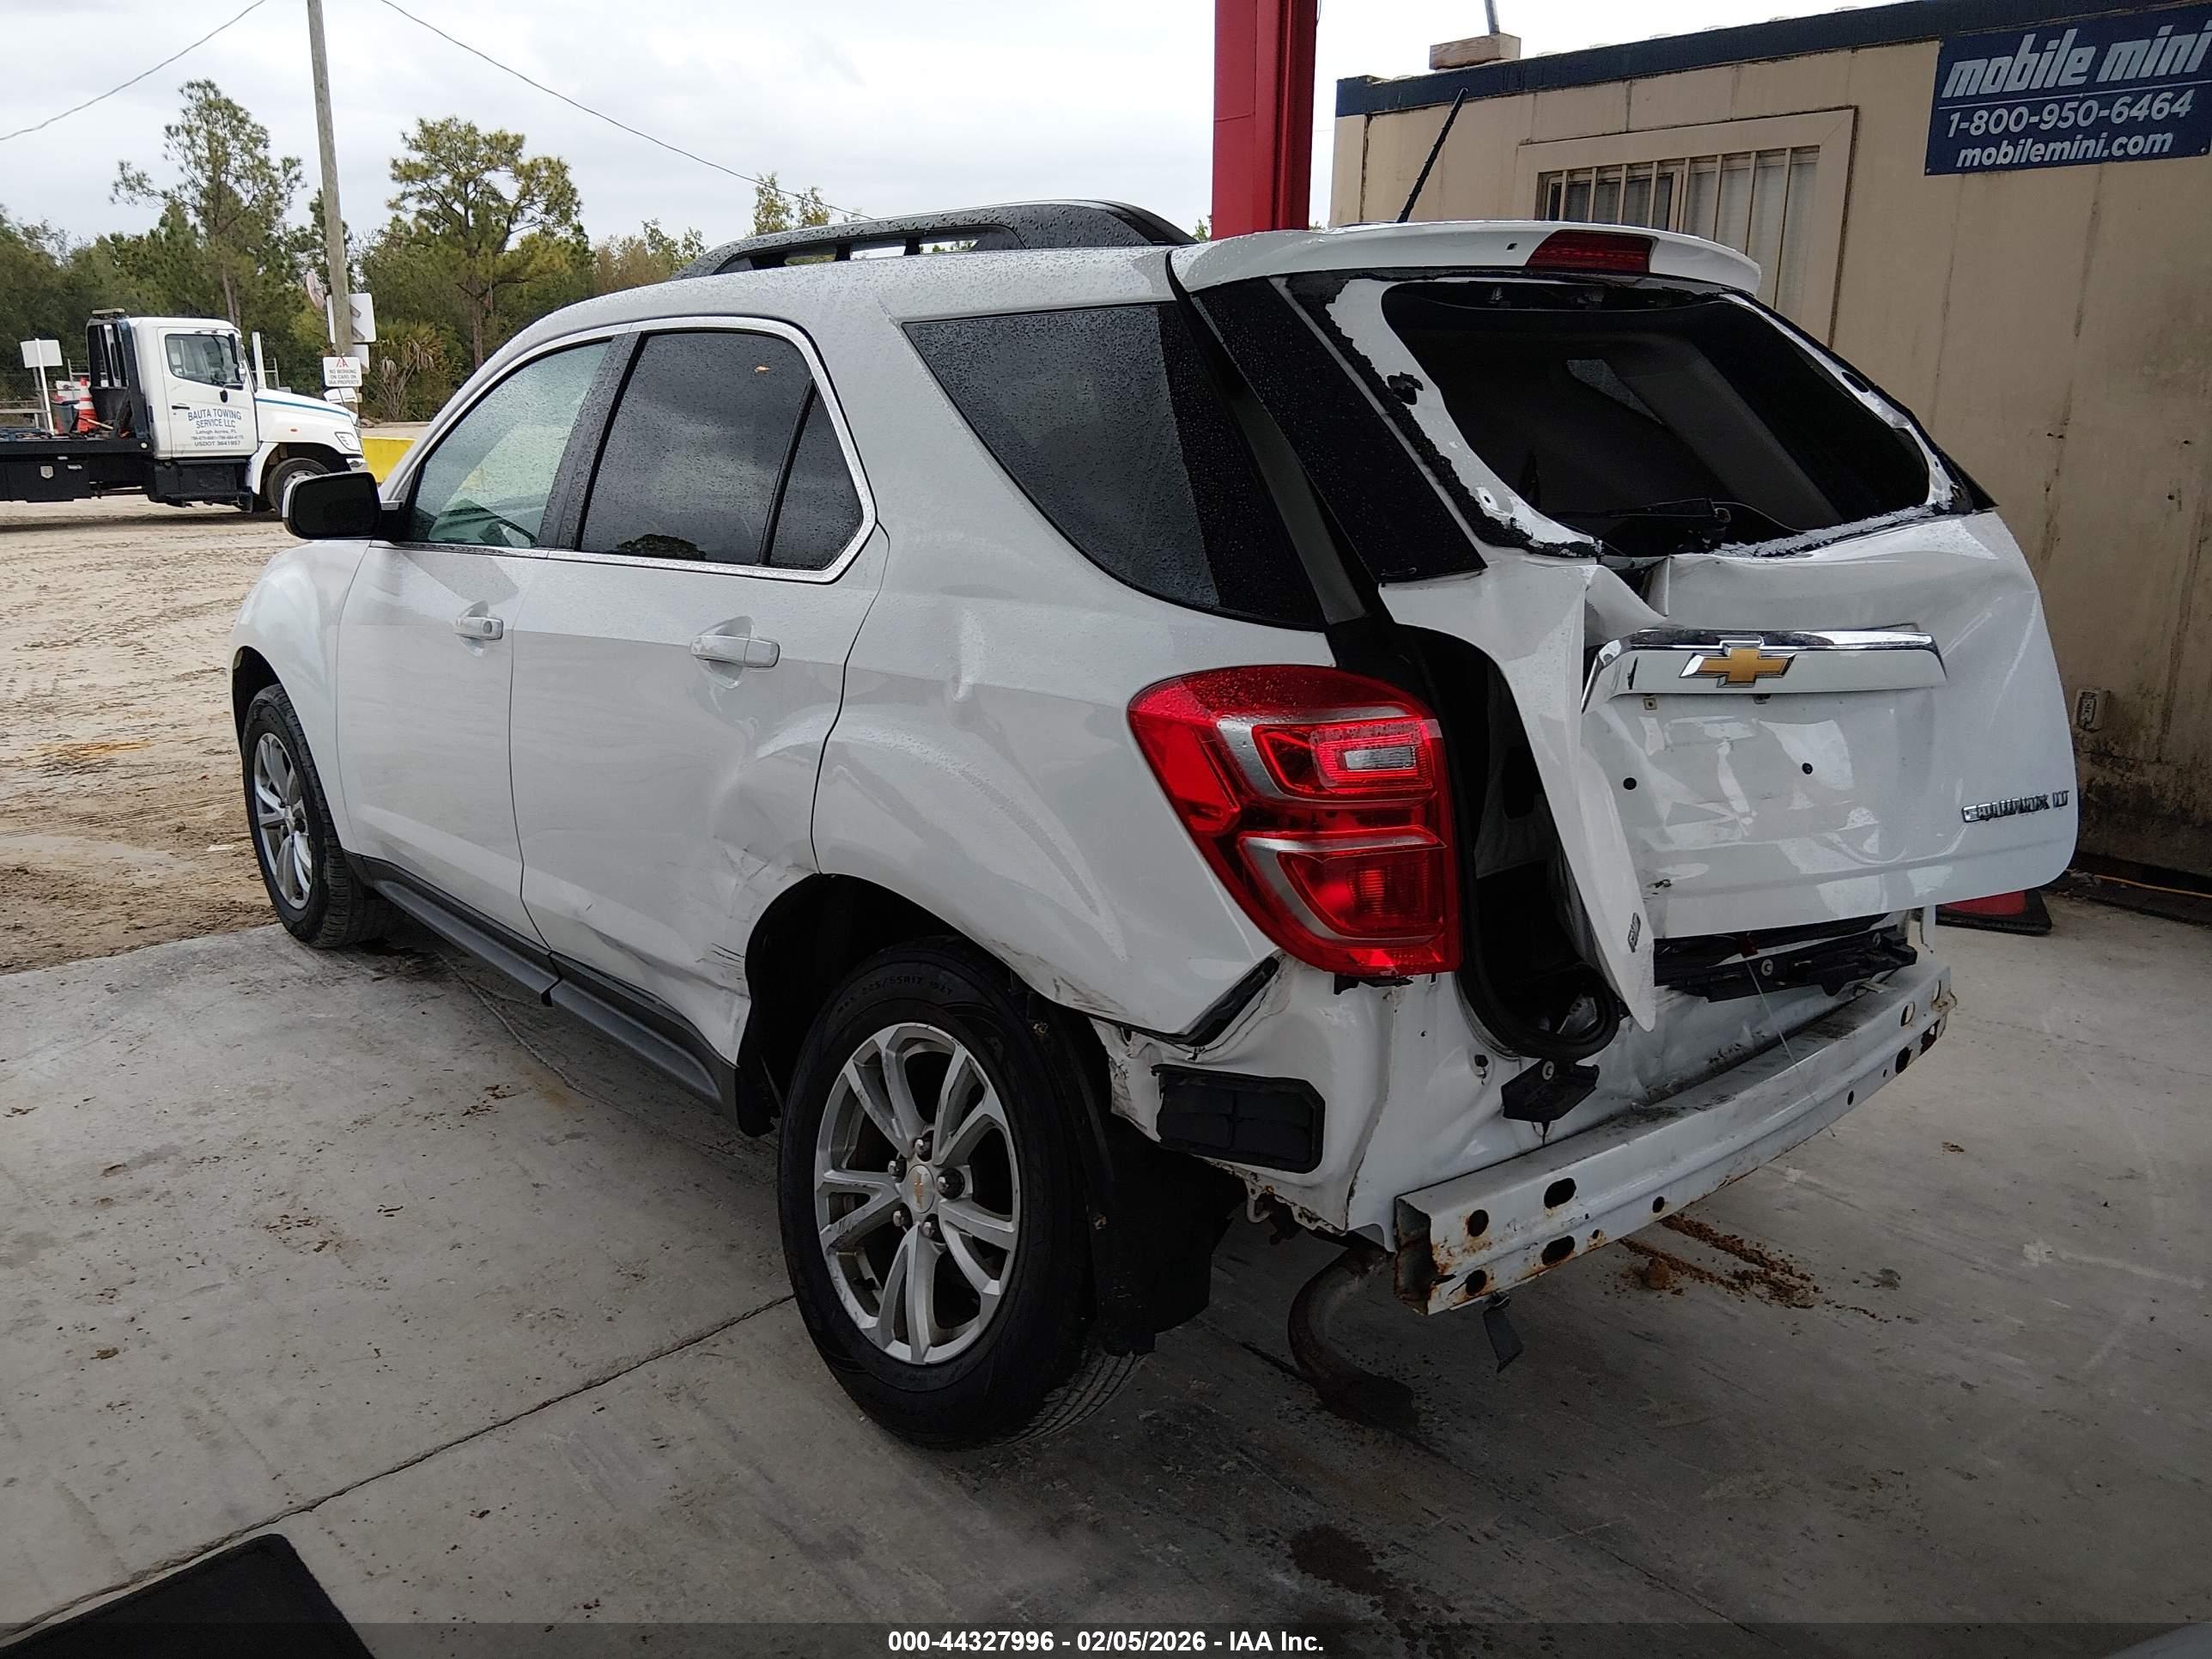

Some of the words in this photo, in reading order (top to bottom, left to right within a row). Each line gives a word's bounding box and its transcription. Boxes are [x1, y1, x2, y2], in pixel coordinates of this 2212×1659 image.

[1941, 27, 2097, 99] mobile
[2095, 19, 2212, 83] mini
[1947, 88, 2196, 138] 1-800-950-6464
[1955, 131, 2175, 168] mobilemini.com
[187, 409, 212, 422] BAUTA
[212, 408, 242, 421] TOWING
[196, 418, 223, 429] SERVICE
[223, 418, 236, 428] LLC
